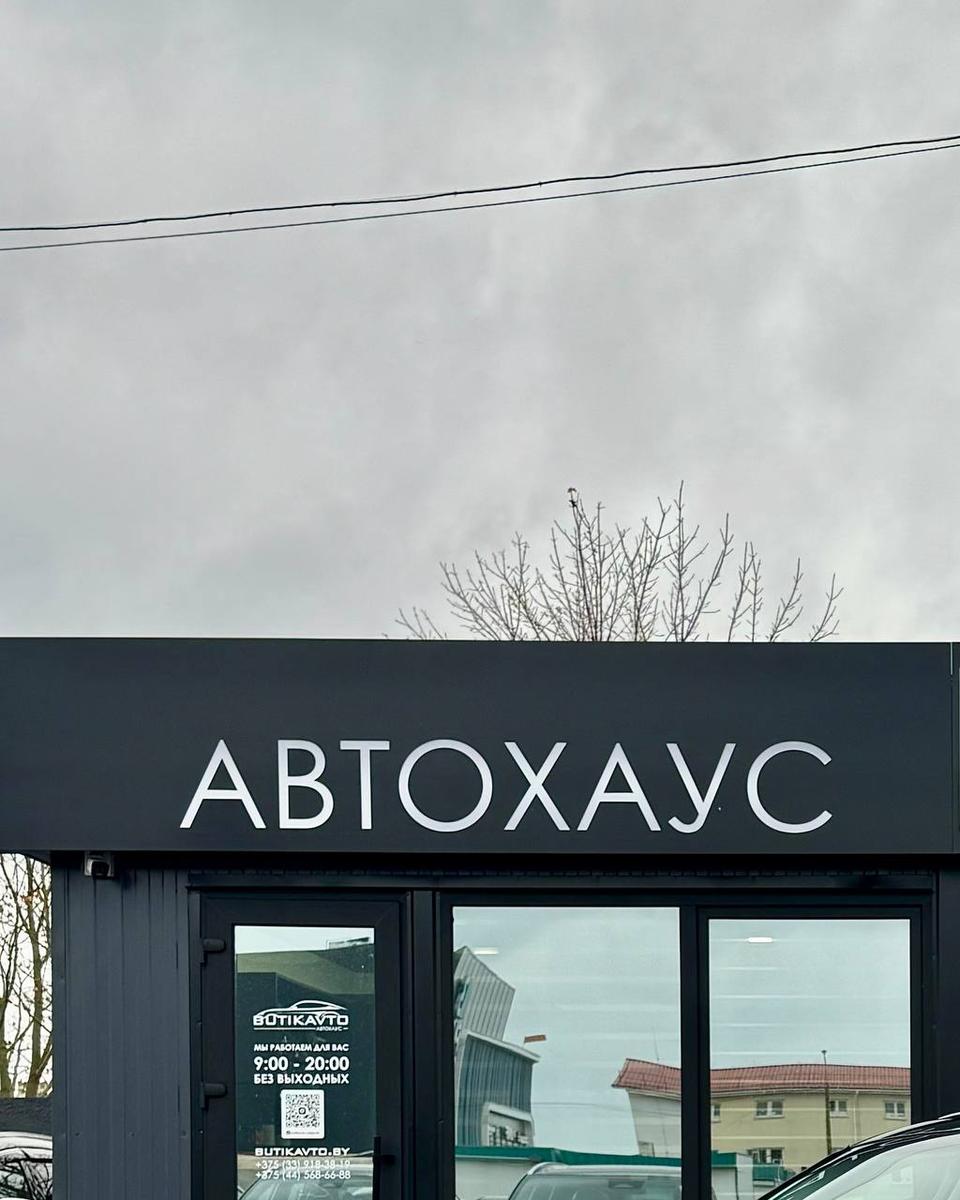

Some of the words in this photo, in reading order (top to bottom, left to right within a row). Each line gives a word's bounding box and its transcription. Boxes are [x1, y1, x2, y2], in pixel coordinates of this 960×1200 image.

[180, 739, 832, 834] АВТОХАУС
[253, 1015, 349, 1026] BUTIKAVTO
[313, 1044, 330, 1052] ДЛЯ
[253, 1056, 288, 1071] 9:00
[305, 1056, 350, 1071] 20:00
[253, 1074, 274, 1084] БЕЗ
[277, 1074, 349, 1085] ВЫХОДНЫХ
[255, 1147, 350, 1156] BUTIKAVTO.BY
[255, 1160, 279, 1170] +375
[282, 1159, 300, 1171] (33)
[303, 1160, 351, 1170] 918-38-19
[255, 1170, 279, 1180] +375
[282, 1169, 300, 1181] (44)
[303, 1170, 351, 1180] 568-66-88
